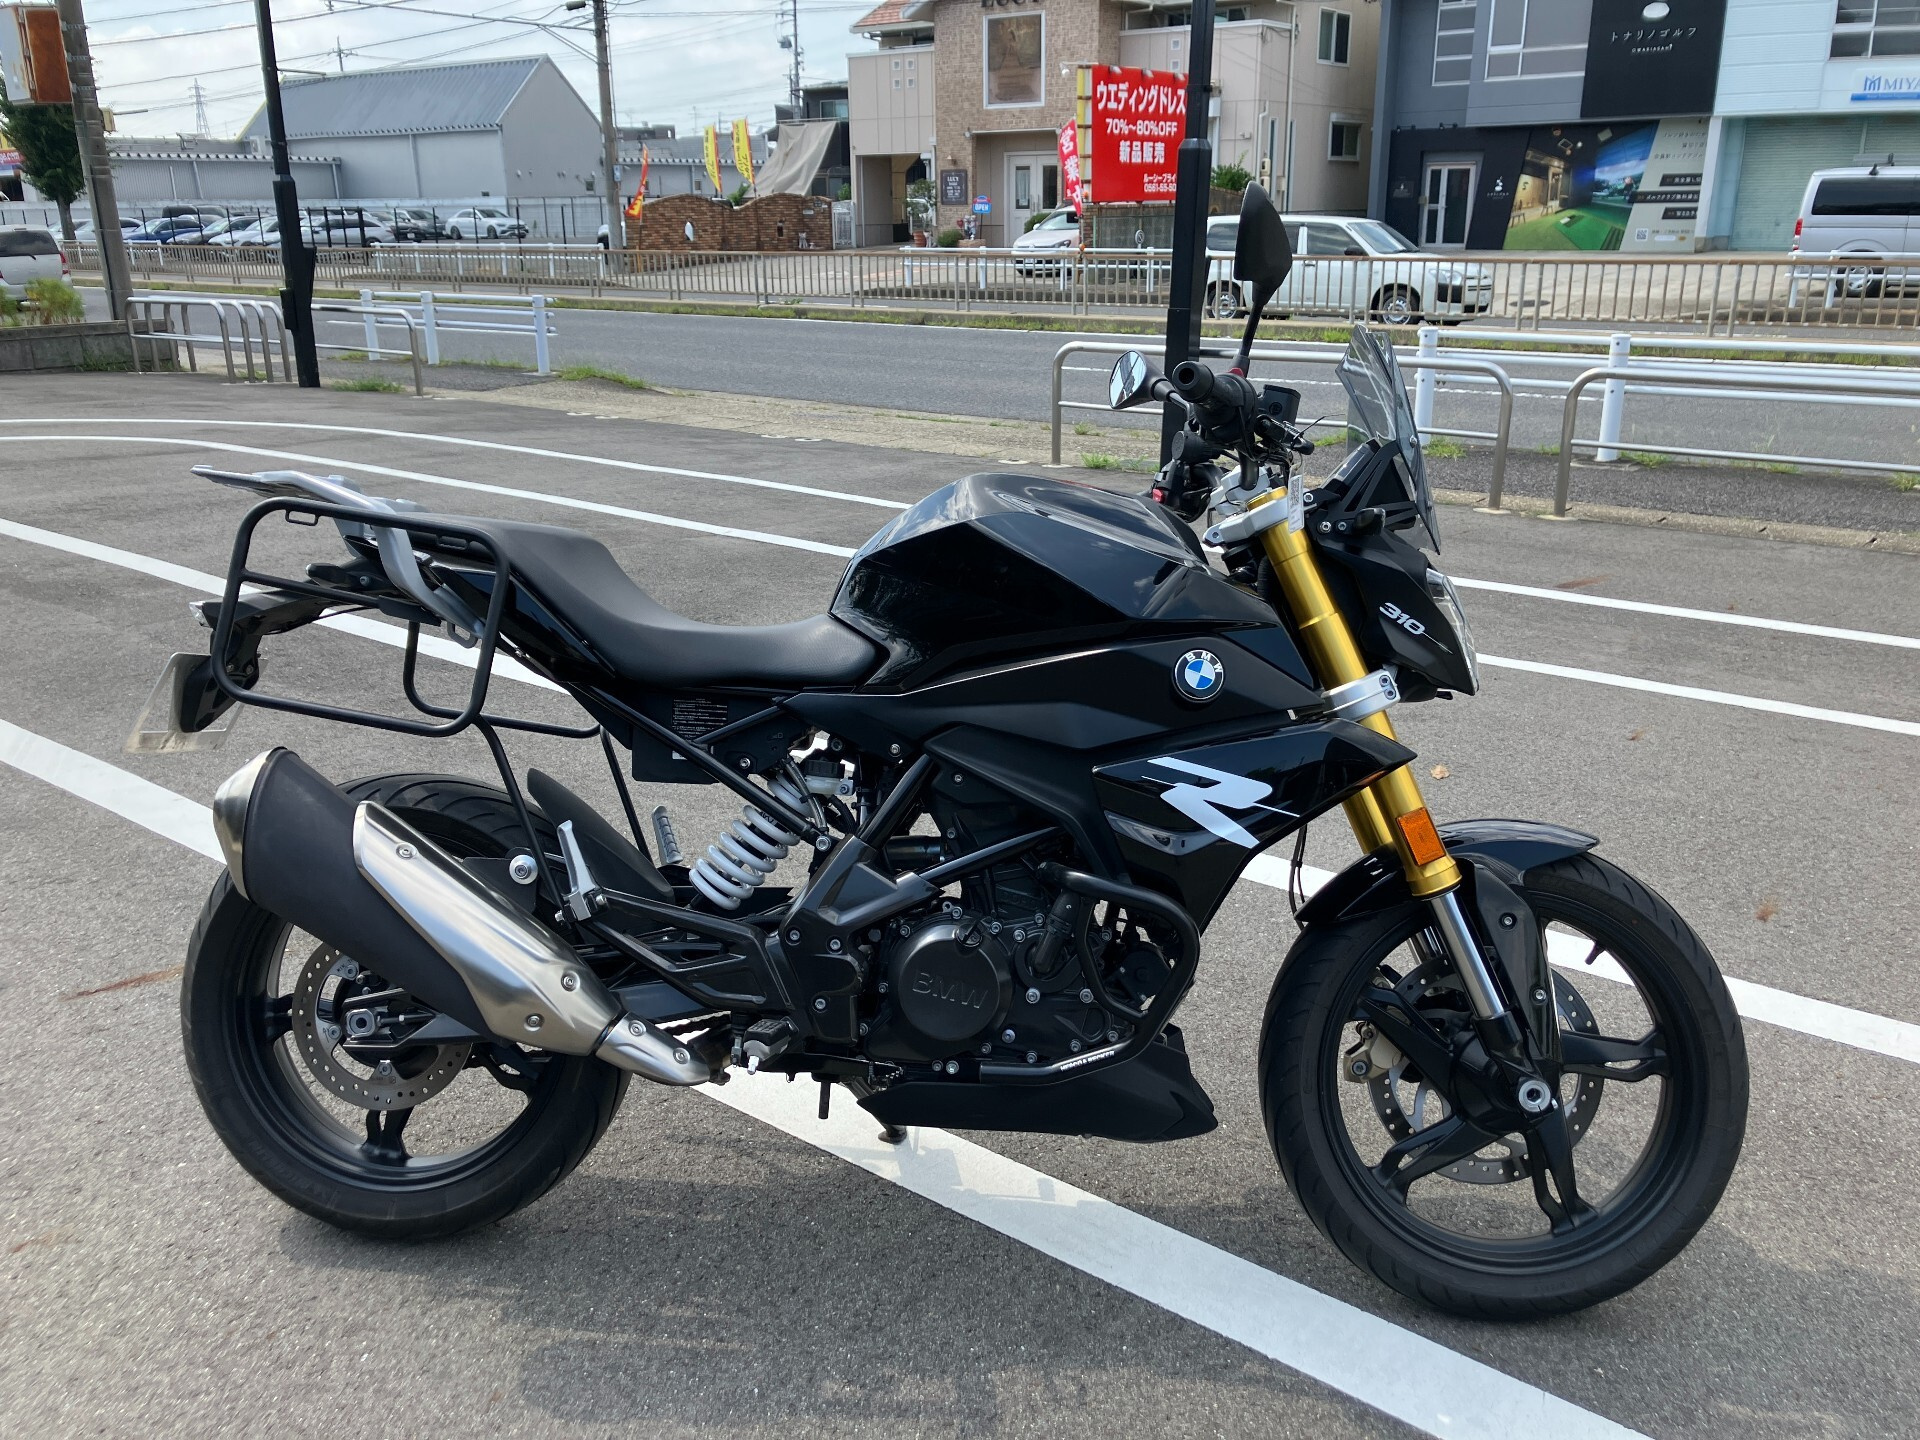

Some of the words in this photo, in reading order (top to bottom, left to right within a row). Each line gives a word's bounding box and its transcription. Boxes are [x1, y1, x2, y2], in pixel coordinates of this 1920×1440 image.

[1611, 27, 1697, 42] トナリノゴルフ
[1096, 80, 1187, 115] ウエディングドレス
[1119, 140, 1165, 164] 新品販売
[974, 203, 989, 211] OPEN
[1379, 602, 1426, 635] 310
[1185, 650, 1223, 673] BMW
[1146, 756, 1287, 849] R
[912, 970, 989, 1009] BMW
